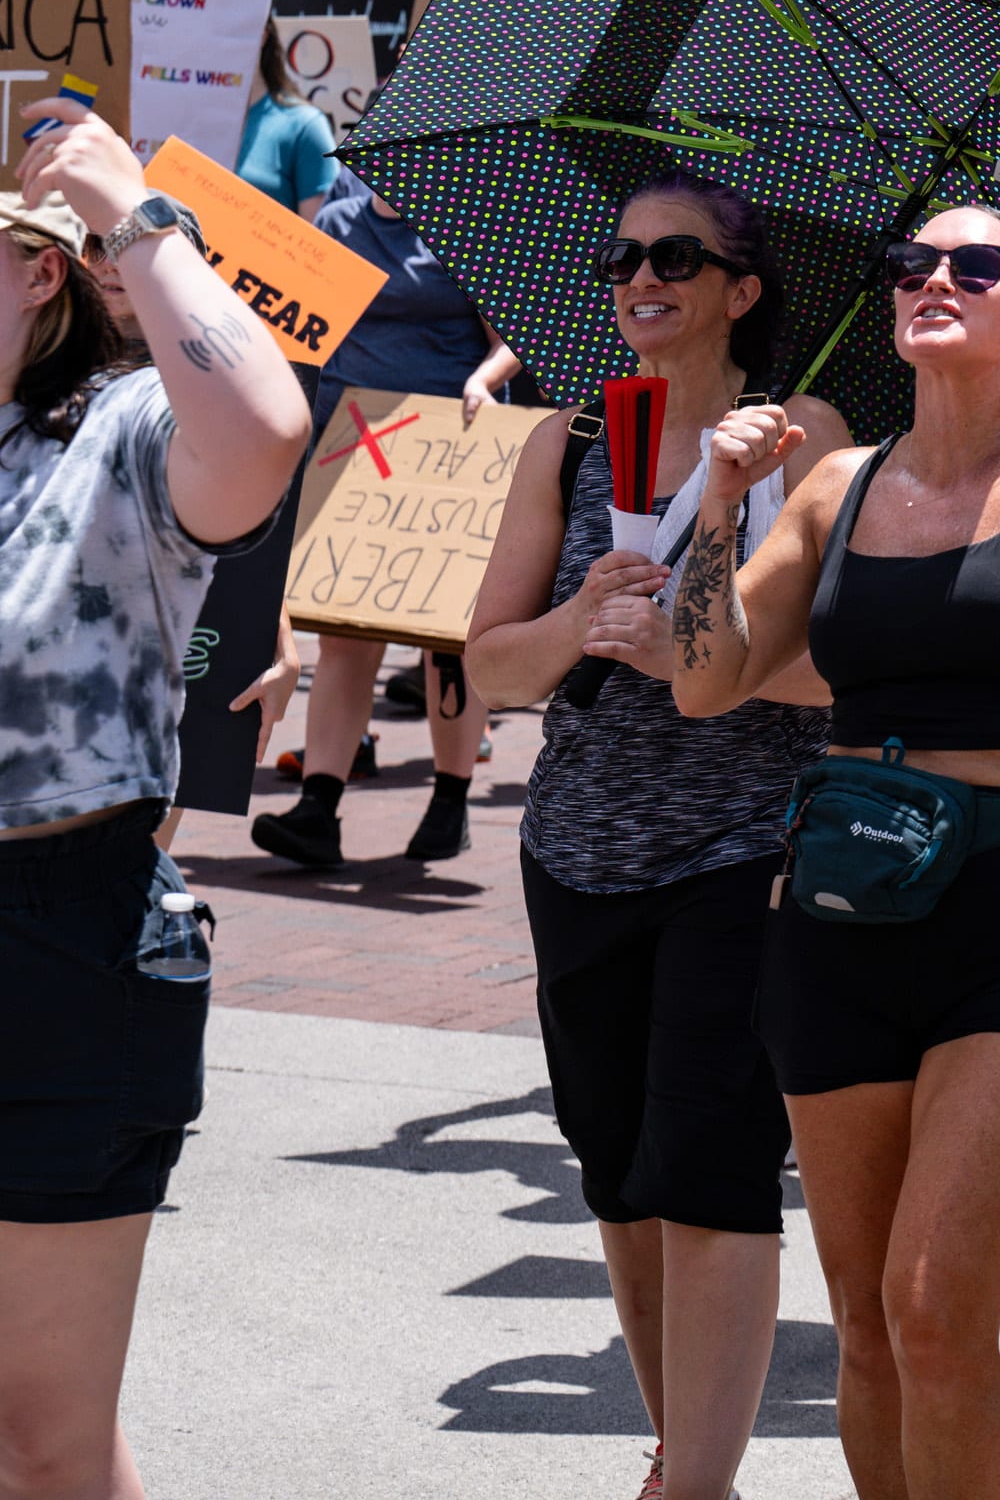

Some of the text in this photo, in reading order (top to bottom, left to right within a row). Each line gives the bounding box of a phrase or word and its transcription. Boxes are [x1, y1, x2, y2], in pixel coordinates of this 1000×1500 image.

[141, 65, 243, 88] FALLS WHEN
[231, 268, 330, 353] FEAR
[415, 437, 479, 479] ALL
[334, 490, 506, 541] JUSTICE
[863, 825, 904, 843] Outdoor
